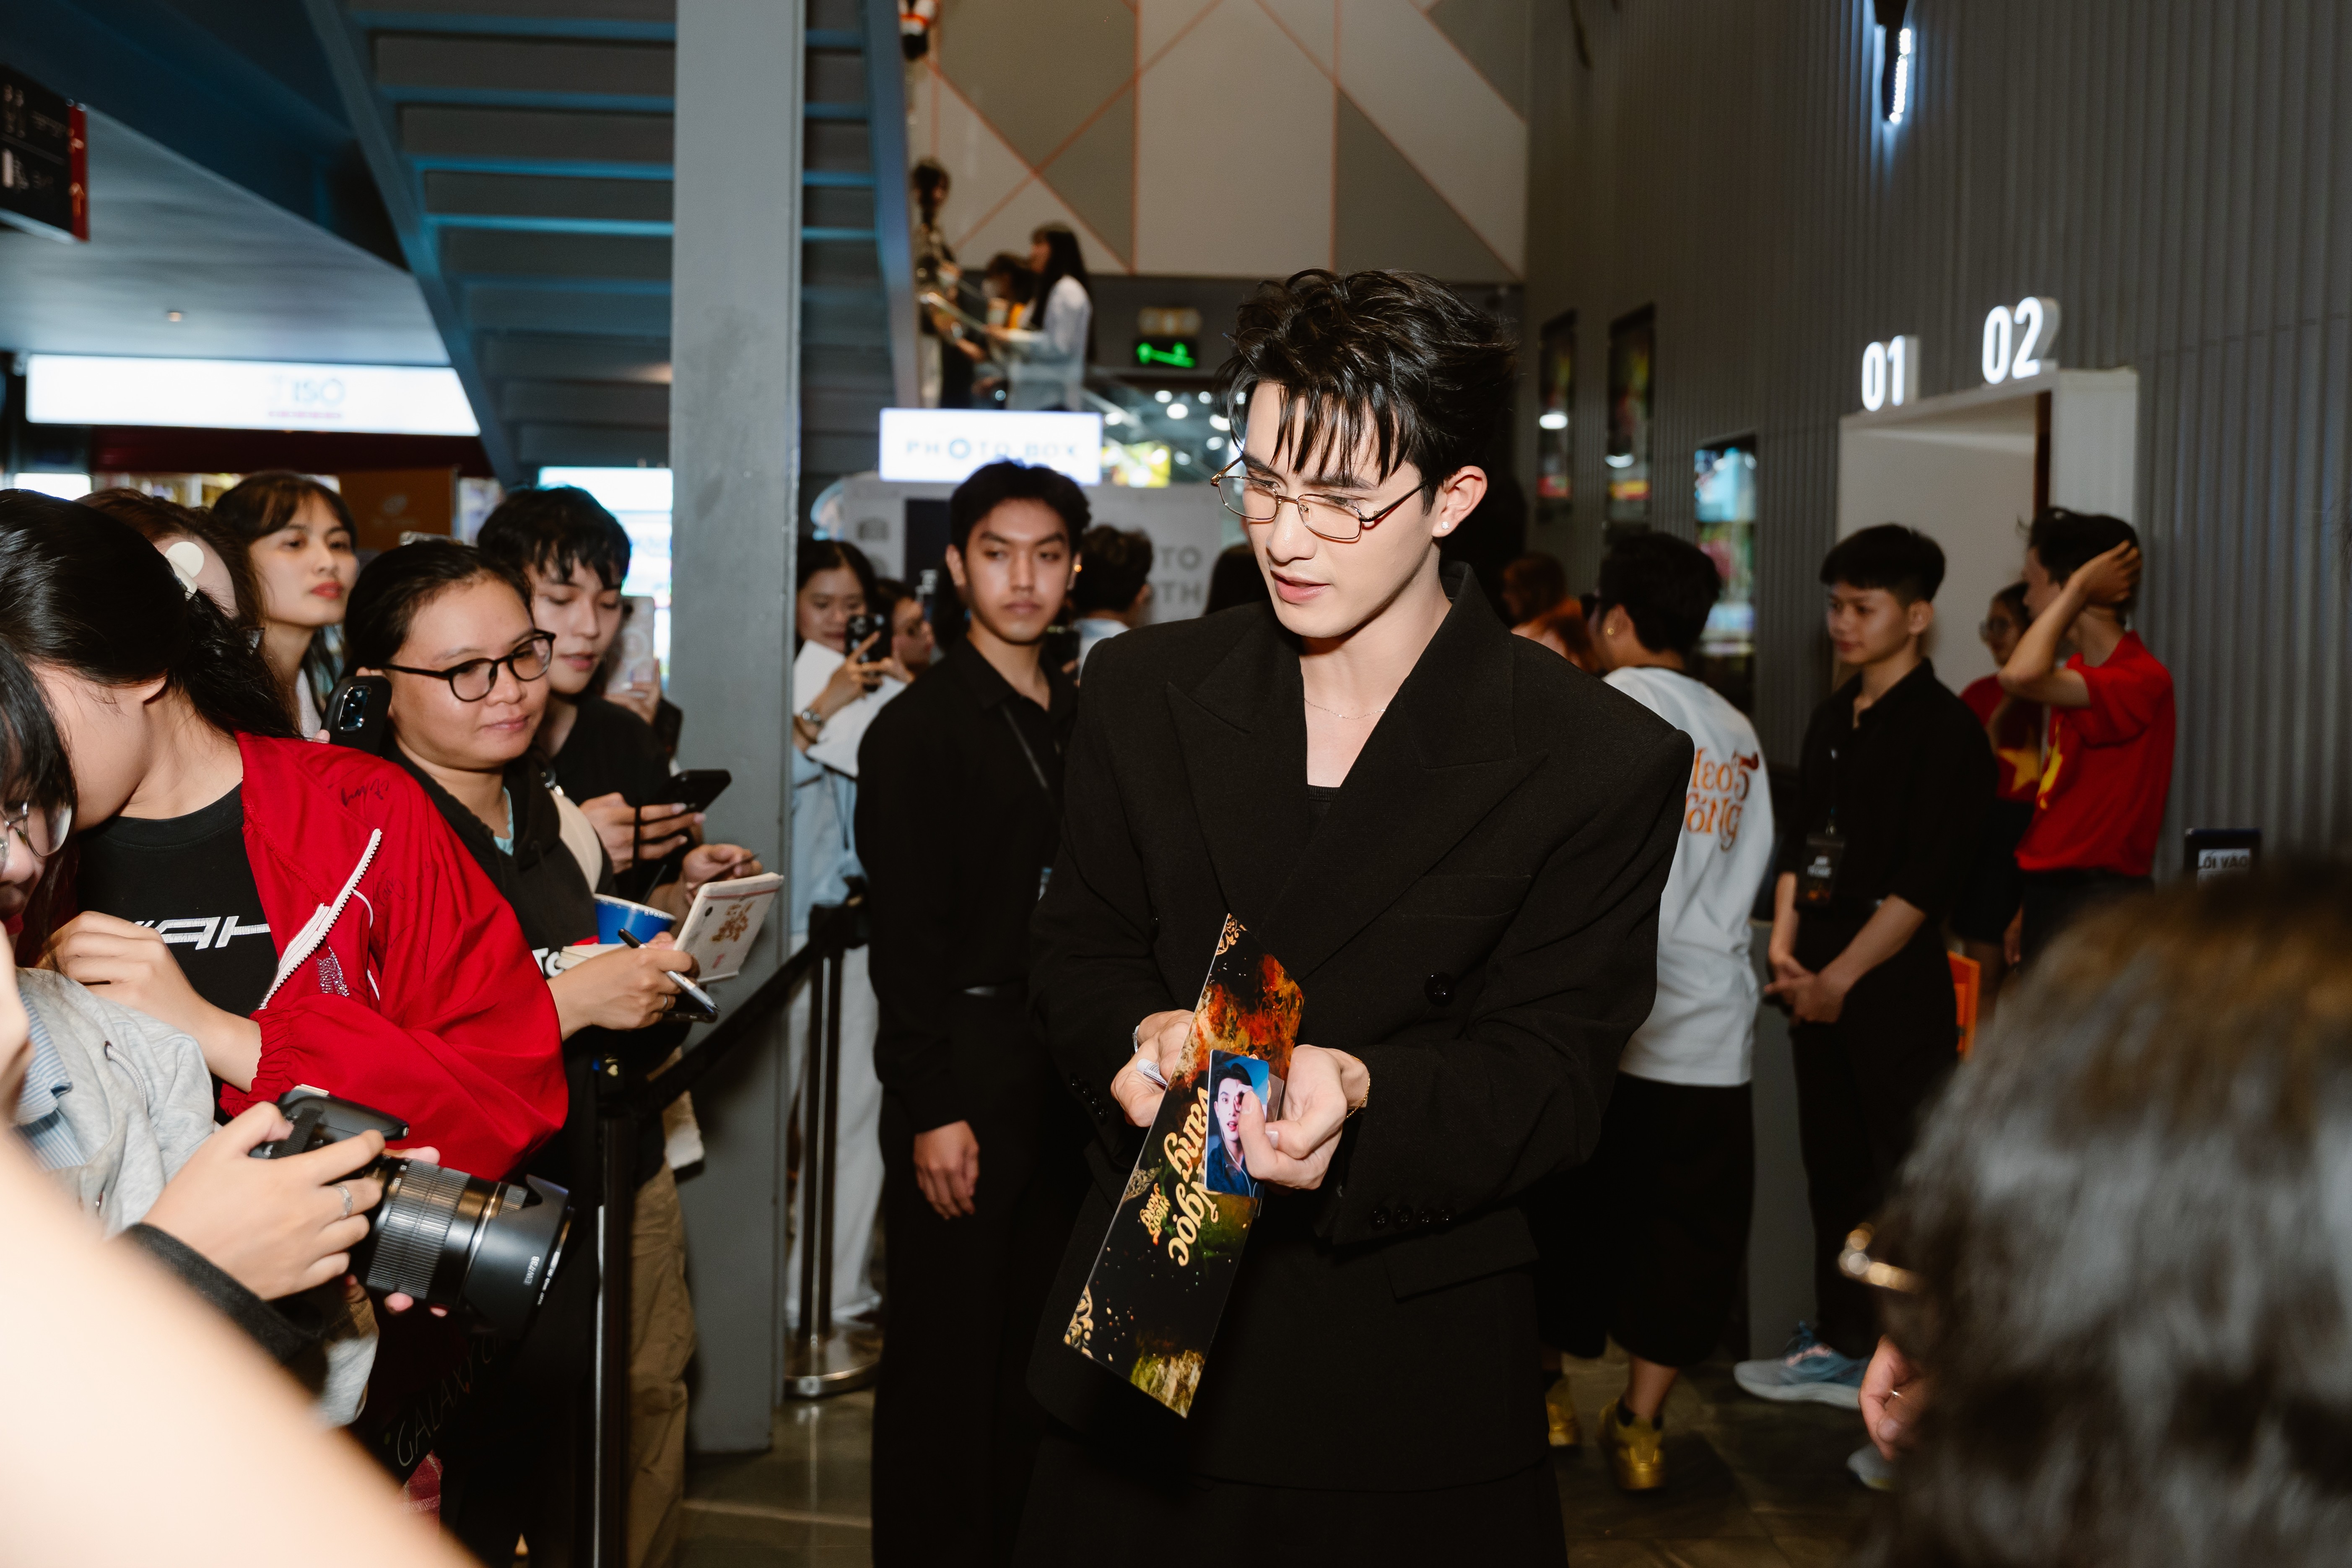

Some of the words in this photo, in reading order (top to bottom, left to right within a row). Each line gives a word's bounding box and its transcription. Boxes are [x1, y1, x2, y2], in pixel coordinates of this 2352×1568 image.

[1861, 335, 1906, 412] 01
[1982, 296, 2044, 385] 02
[906, 438, 1010, 460] PHOTO
[1025, 441, 1076, 457] BOX
[397, 1341, 475, 1467] GALAXY
